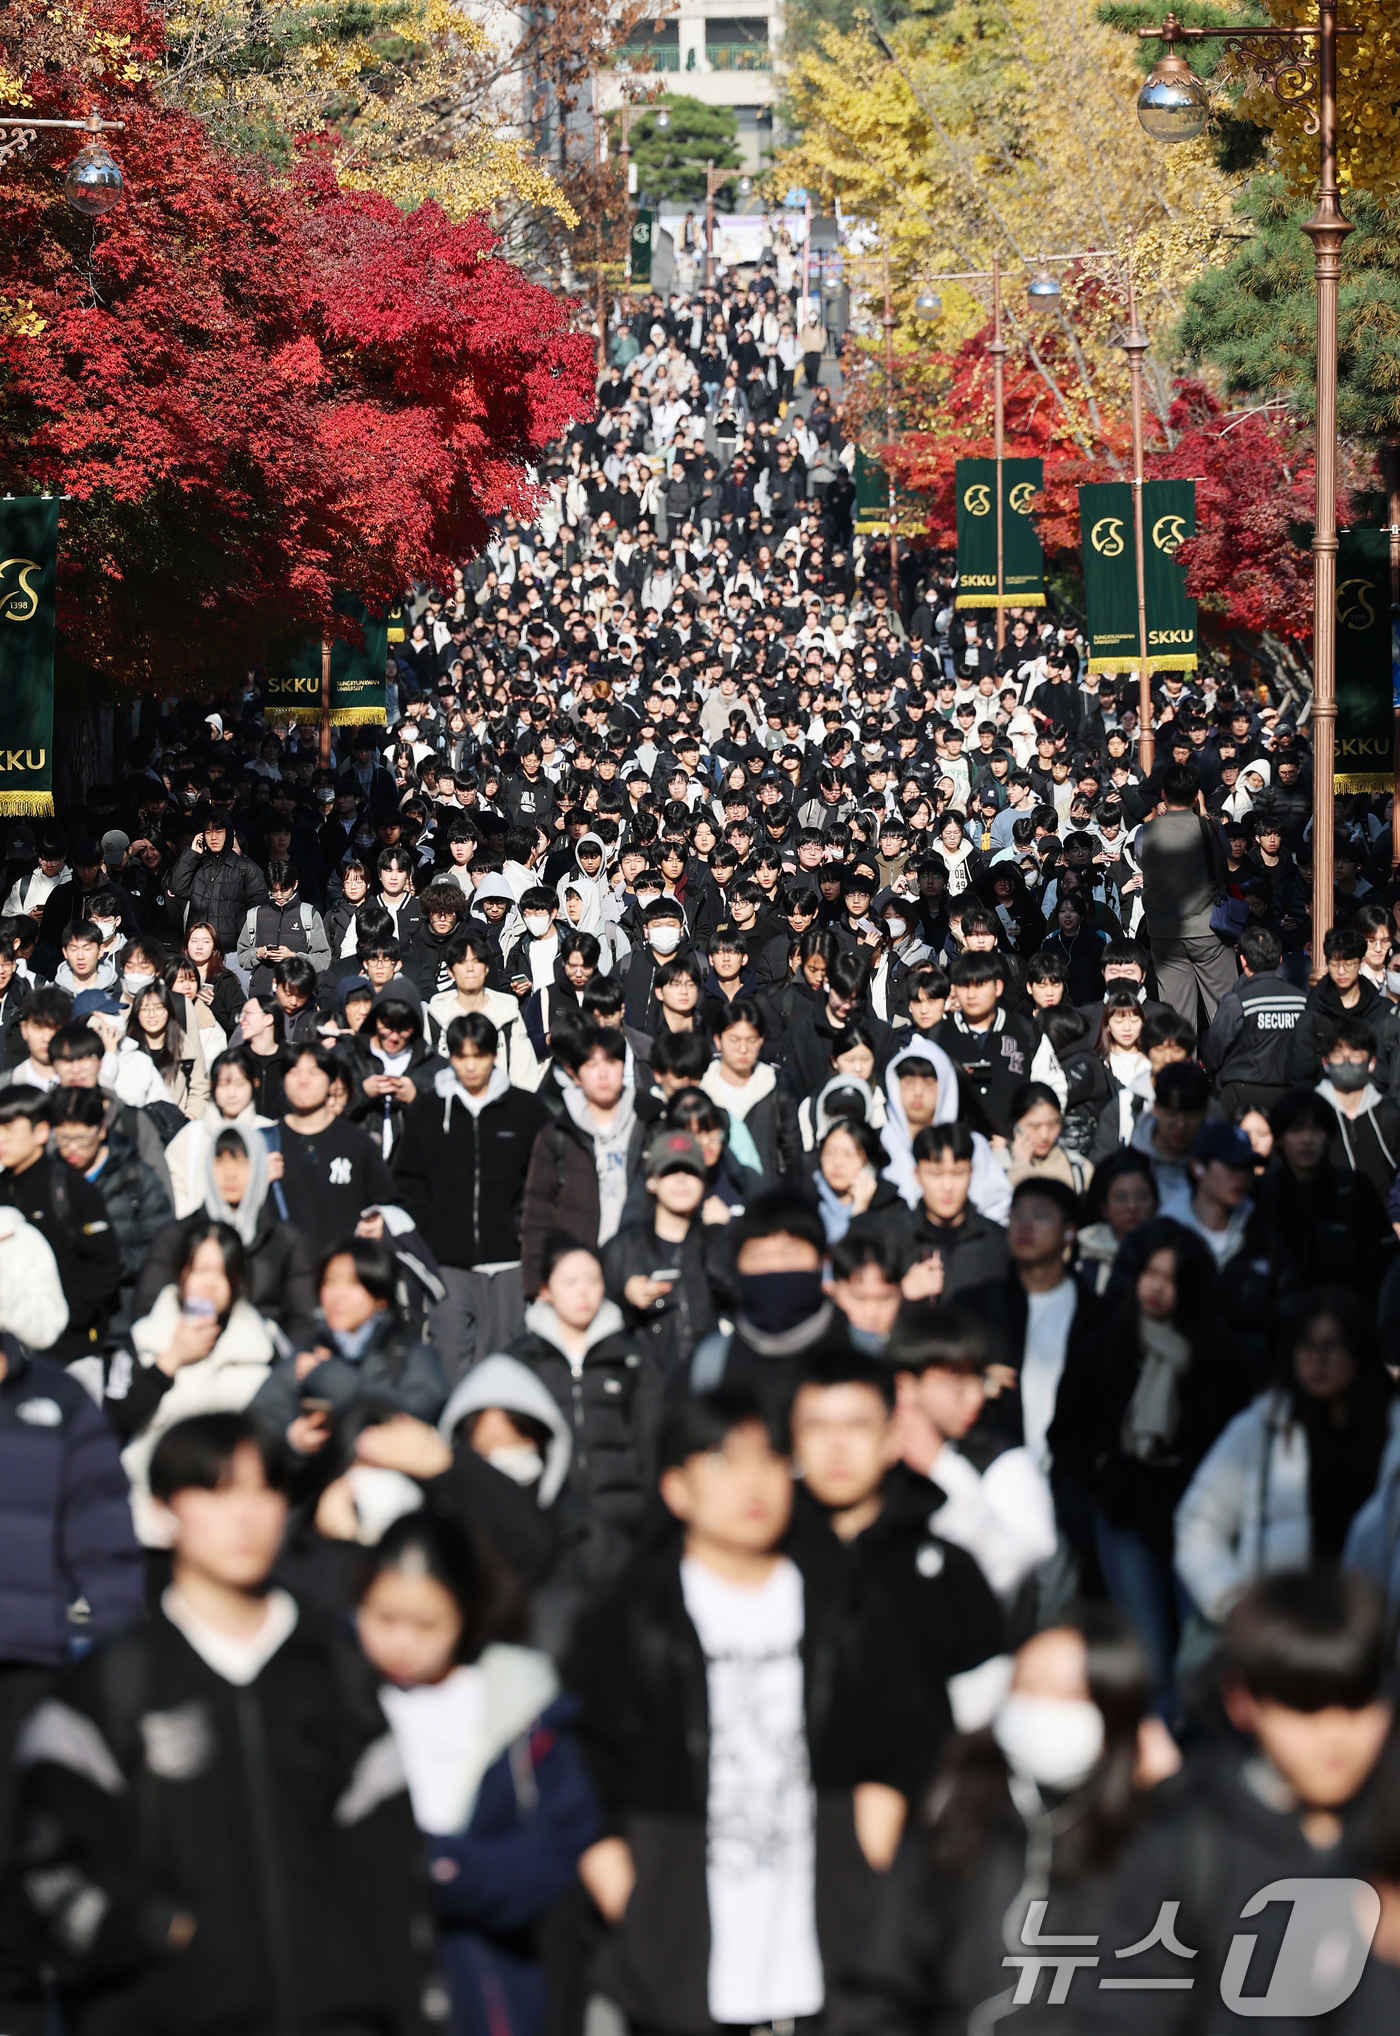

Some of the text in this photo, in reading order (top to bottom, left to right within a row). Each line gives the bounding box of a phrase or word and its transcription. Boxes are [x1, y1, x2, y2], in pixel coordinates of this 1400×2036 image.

[960, 574, 997, 587] SKKU
[10, 601, 28, 610] 1398
[1148, 629, 1194, 645] SKKU
[268, 677, 319, 693] SKKU
